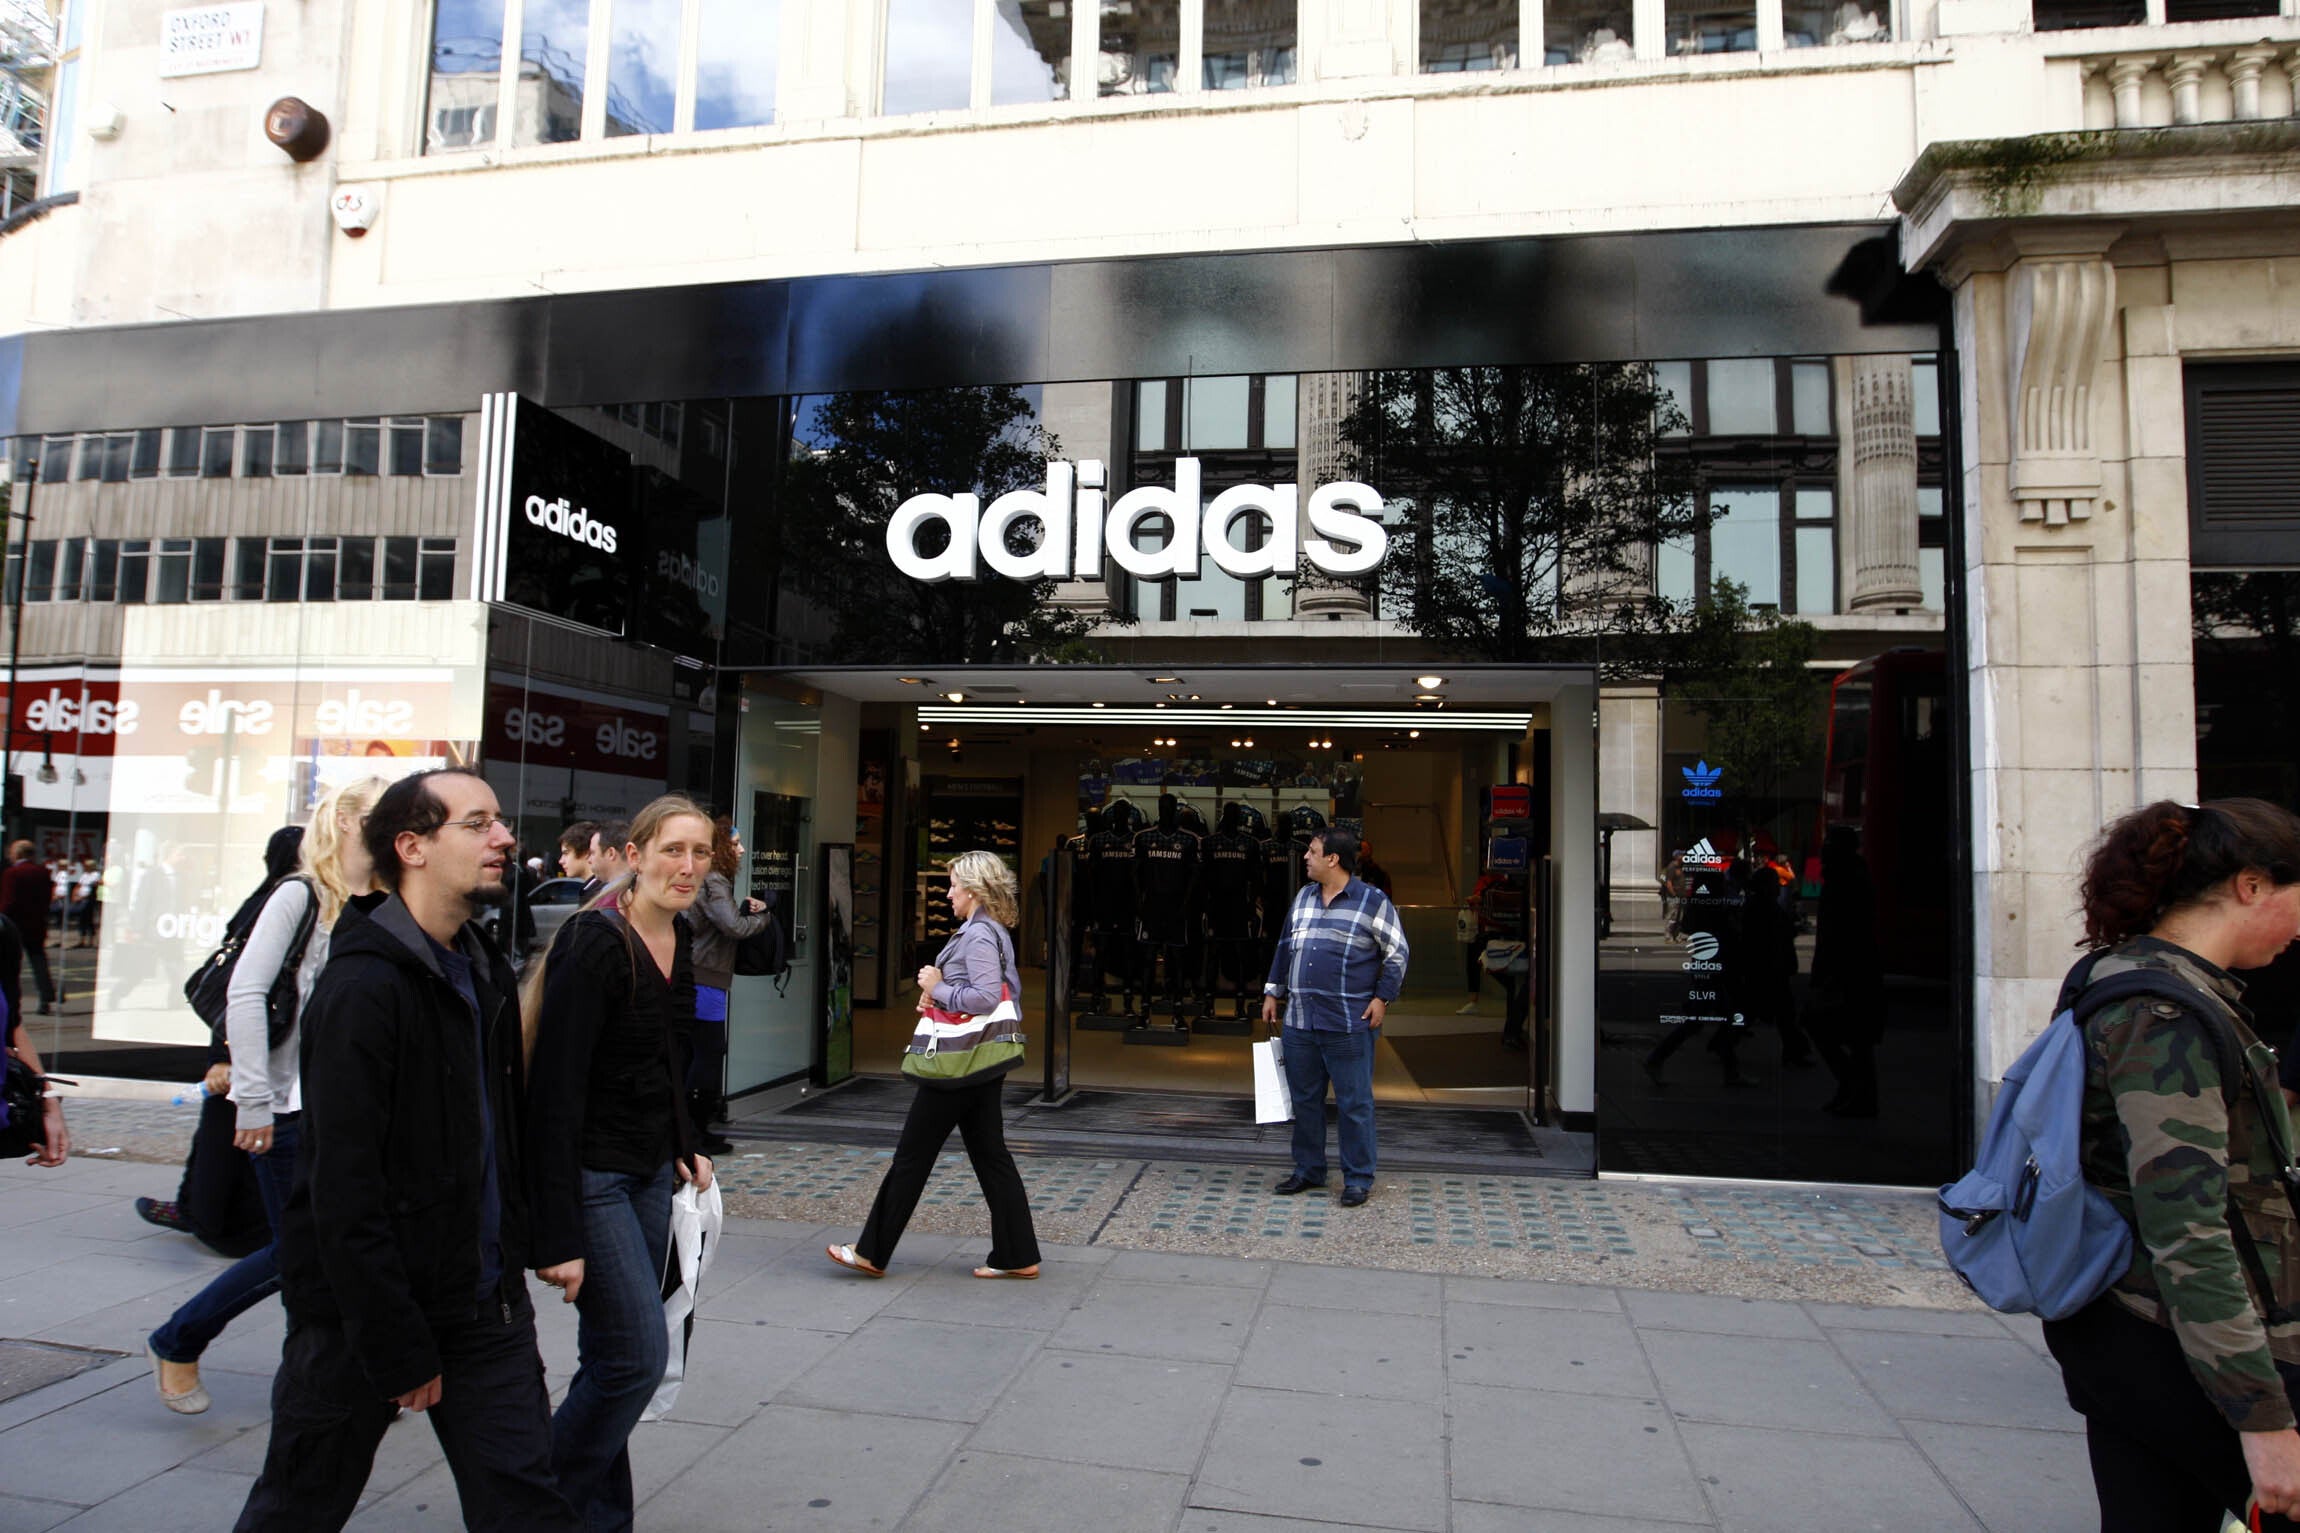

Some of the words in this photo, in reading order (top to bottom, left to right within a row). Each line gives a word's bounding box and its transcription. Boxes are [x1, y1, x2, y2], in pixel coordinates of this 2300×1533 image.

[170, 10, 231, 33] OXFORD
[169, 31, 222, 54] STREET
[525, 494, 618, 553] adidas
[886, 456, 1389, 580] adidas
[1682, 786, 1723, 798] adidas
[1682, 853, 1723, 864] adidas
[1682, 960, 1722, 971] adidas
[1688, 990, 1717, 1001] SLVR
